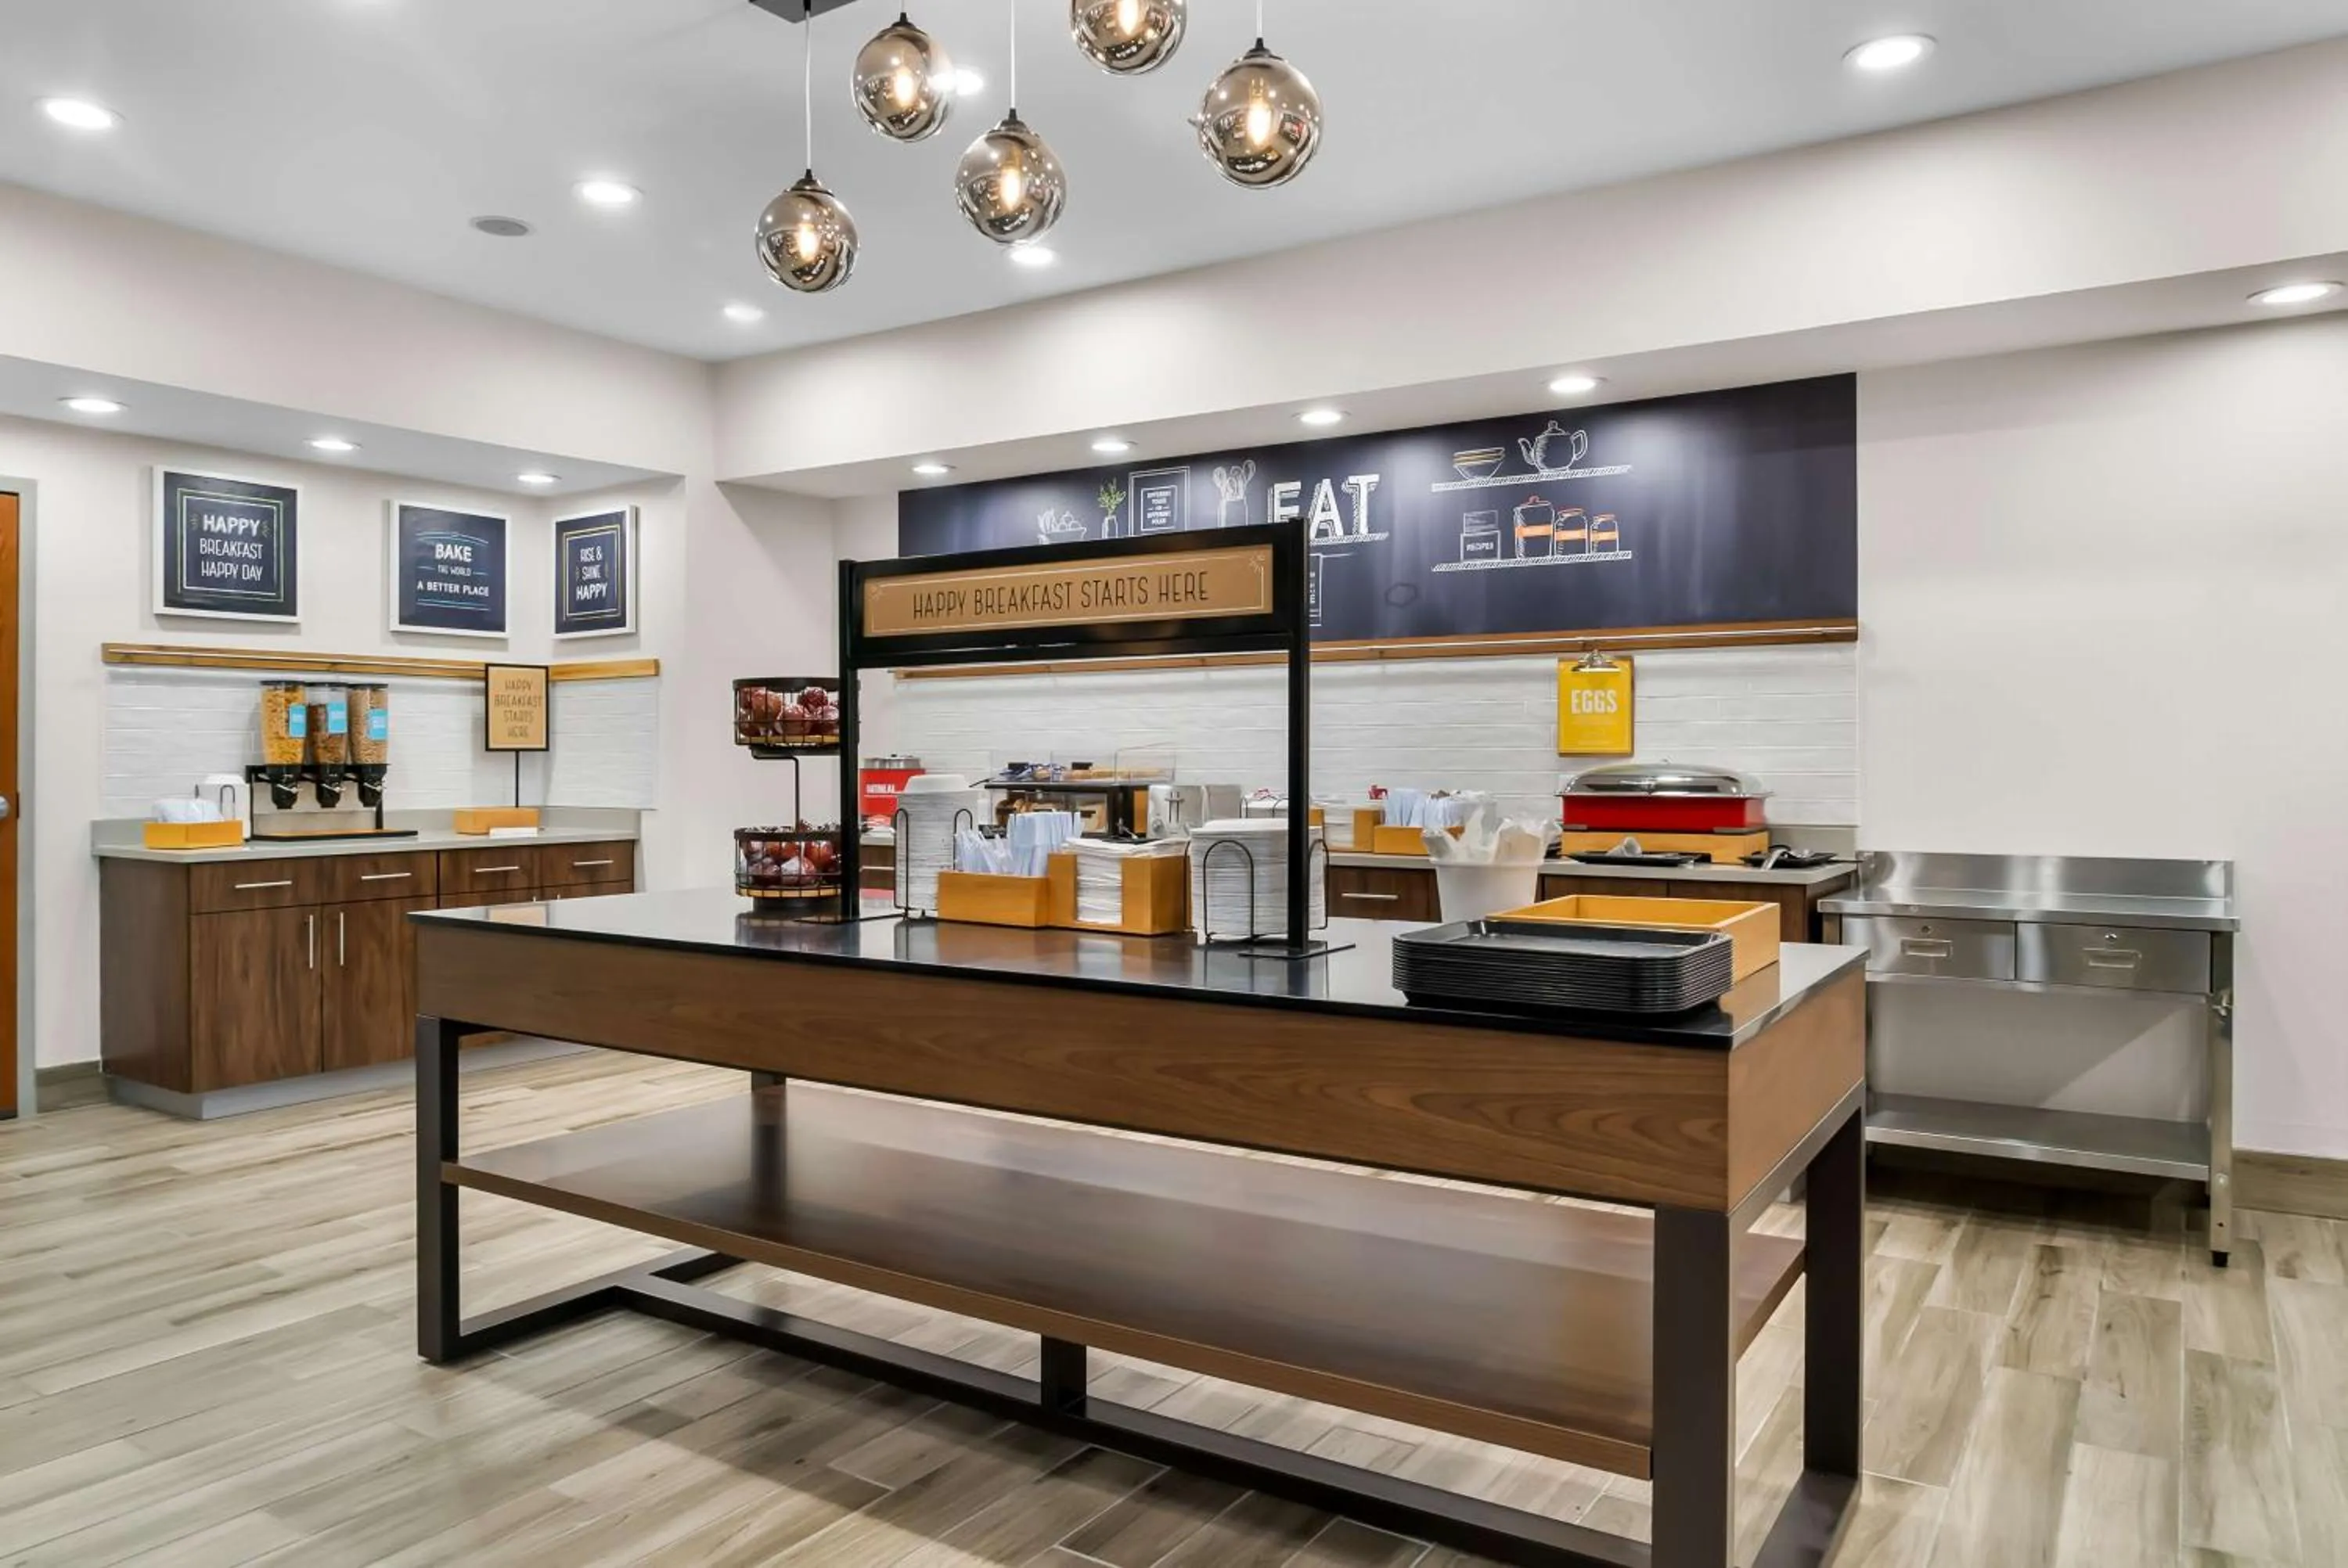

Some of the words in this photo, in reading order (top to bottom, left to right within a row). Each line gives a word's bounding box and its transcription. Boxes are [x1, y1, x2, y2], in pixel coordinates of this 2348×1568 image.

[1268, 473, 1380, 540] EAT
[203, 514, 260, 537] HAPPY
[200, 538, 263, 559] BREAKFAST
[435, 543, 473, 562] BAKE
[201, 560, 239, 578] HAPPY
[242, 564, 263, 581] DAY
[417, 581, 424, 591] A
[427, 581, 460, 594] BETTER
[463, 584, 489, 597] PLACE
[576, 582, 608, 601] HAPPY
[913, 590, 967, 620] HAPPY
[974, 581, 1074, 616] BREAKFAST
[1081, 576, 1149, 609] STARTS
[1158, 570, 1209, 603] HERE
[505, 679, 531, 691] HAPPY
[495, 694, 542, 708] BREAKFAST
[1571, 689, 1619, 714] EGGS
